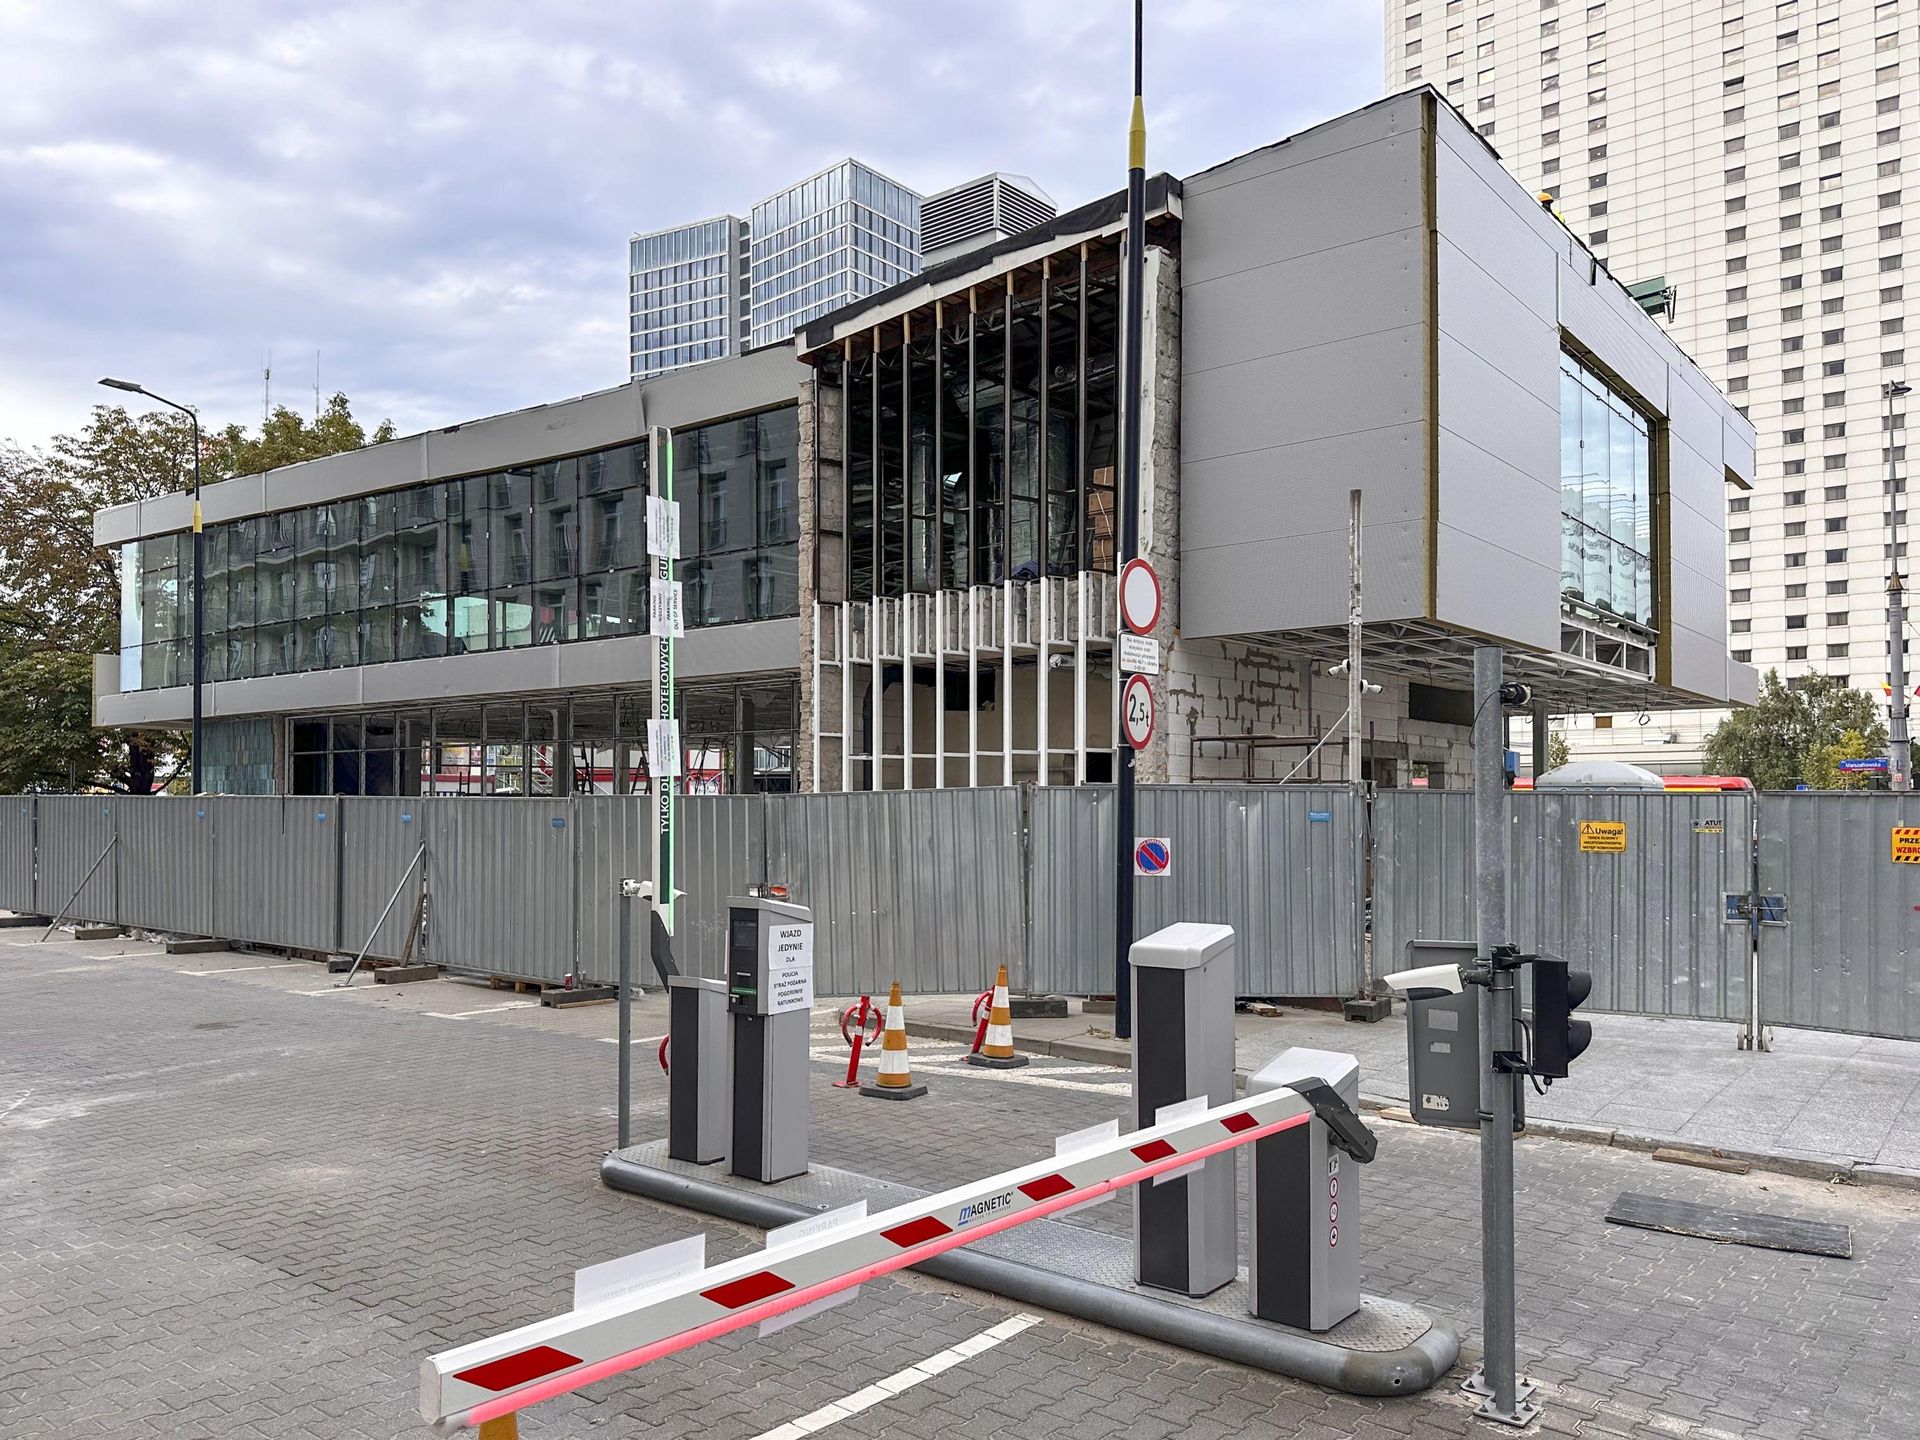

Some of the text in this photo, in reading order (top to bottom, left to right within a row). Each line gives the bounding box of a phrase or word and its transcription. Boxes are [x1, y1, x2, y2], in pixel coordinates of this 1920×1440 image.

[660, 635, 669, 720] HOTELOWYCH
[660, 776, 669, 791] DL
[660, 795, 669, 834] TYLKO
[1595, 828, 1624, 836] Uwaga!
[779, 930, 802, 938] WJAZD
[778, 943, 803, 952] JEDYNIE
